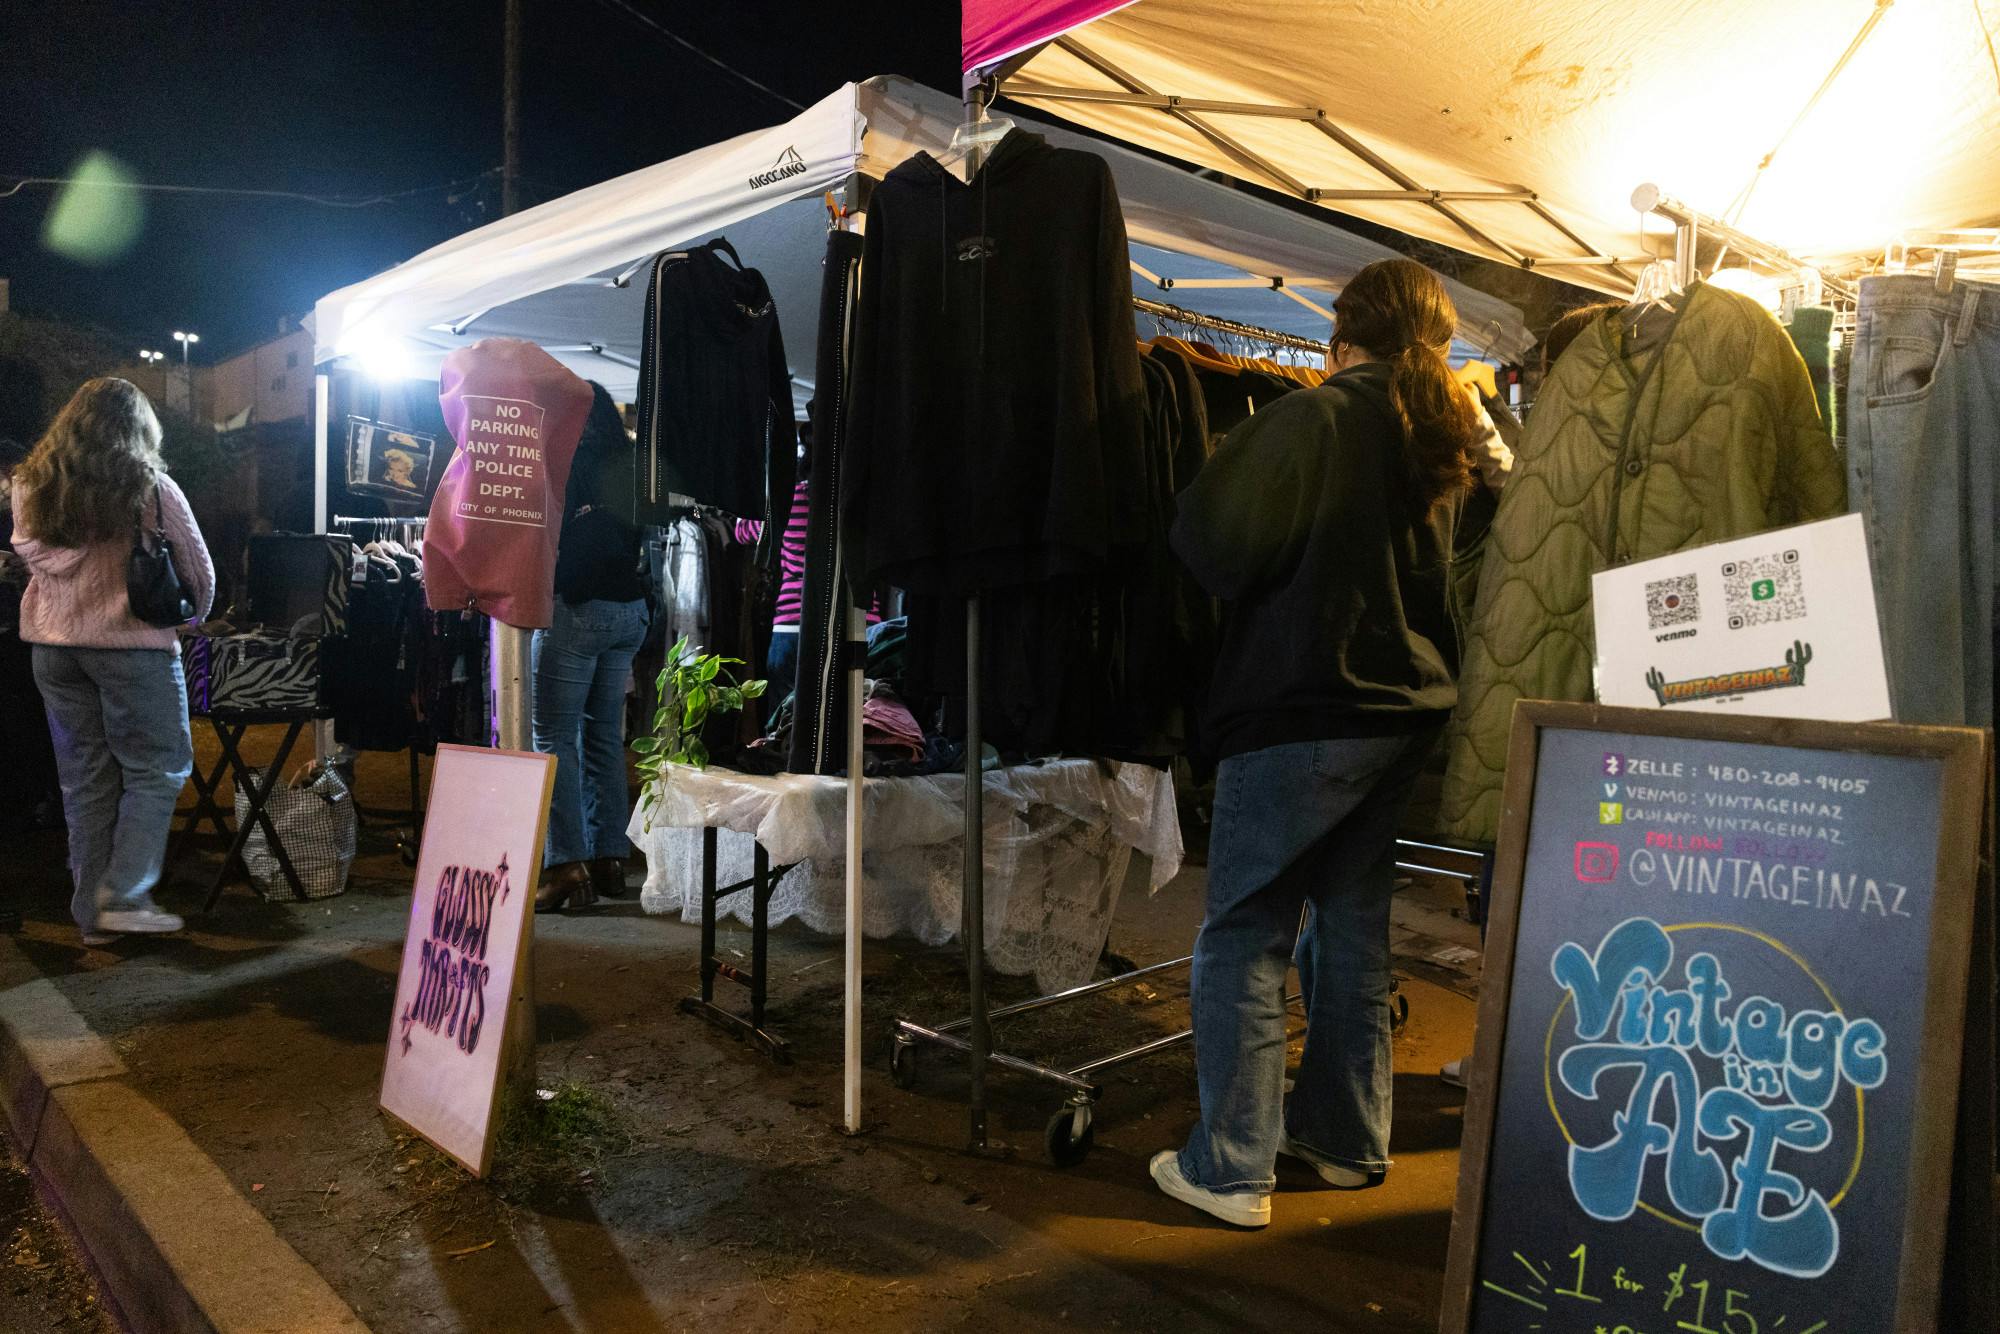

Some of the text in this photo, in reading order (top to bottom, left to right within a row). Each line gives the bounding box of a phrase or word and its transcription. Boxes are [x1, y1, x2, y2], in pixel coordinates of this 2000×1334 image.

[496, 404, 521, 418] NO
[470, 419, 539, 440] PARKING
[465, 440, 542, 462] ANY TIME
[475, 459, 534, 478] POLICE
[479, 483, 525, 500] DEPT.
[460, 502, 543, 520] CITY OF PHOENIX
[1655, 628, 1697, 643] venmo
[1663, 666, 1792, 698] VINTAGEINAZ
[1707, 764, 1870, 795] 480-208-9405
[1645, 831, 1724, 852] FOLLOW
[1628, 849, 1912, 918] @VINTAGEINAZ
[432, 864, 499, 961] GLOSSY
[411, 938, 489, 1055] THRIFTS
[1551, 916, 1887, 1110] Vintage
[1723, 1053, 1784, 1099] in
[1555, 1243, 1603, 1303] 1
[1612, 1266, 1645, 1294] for
